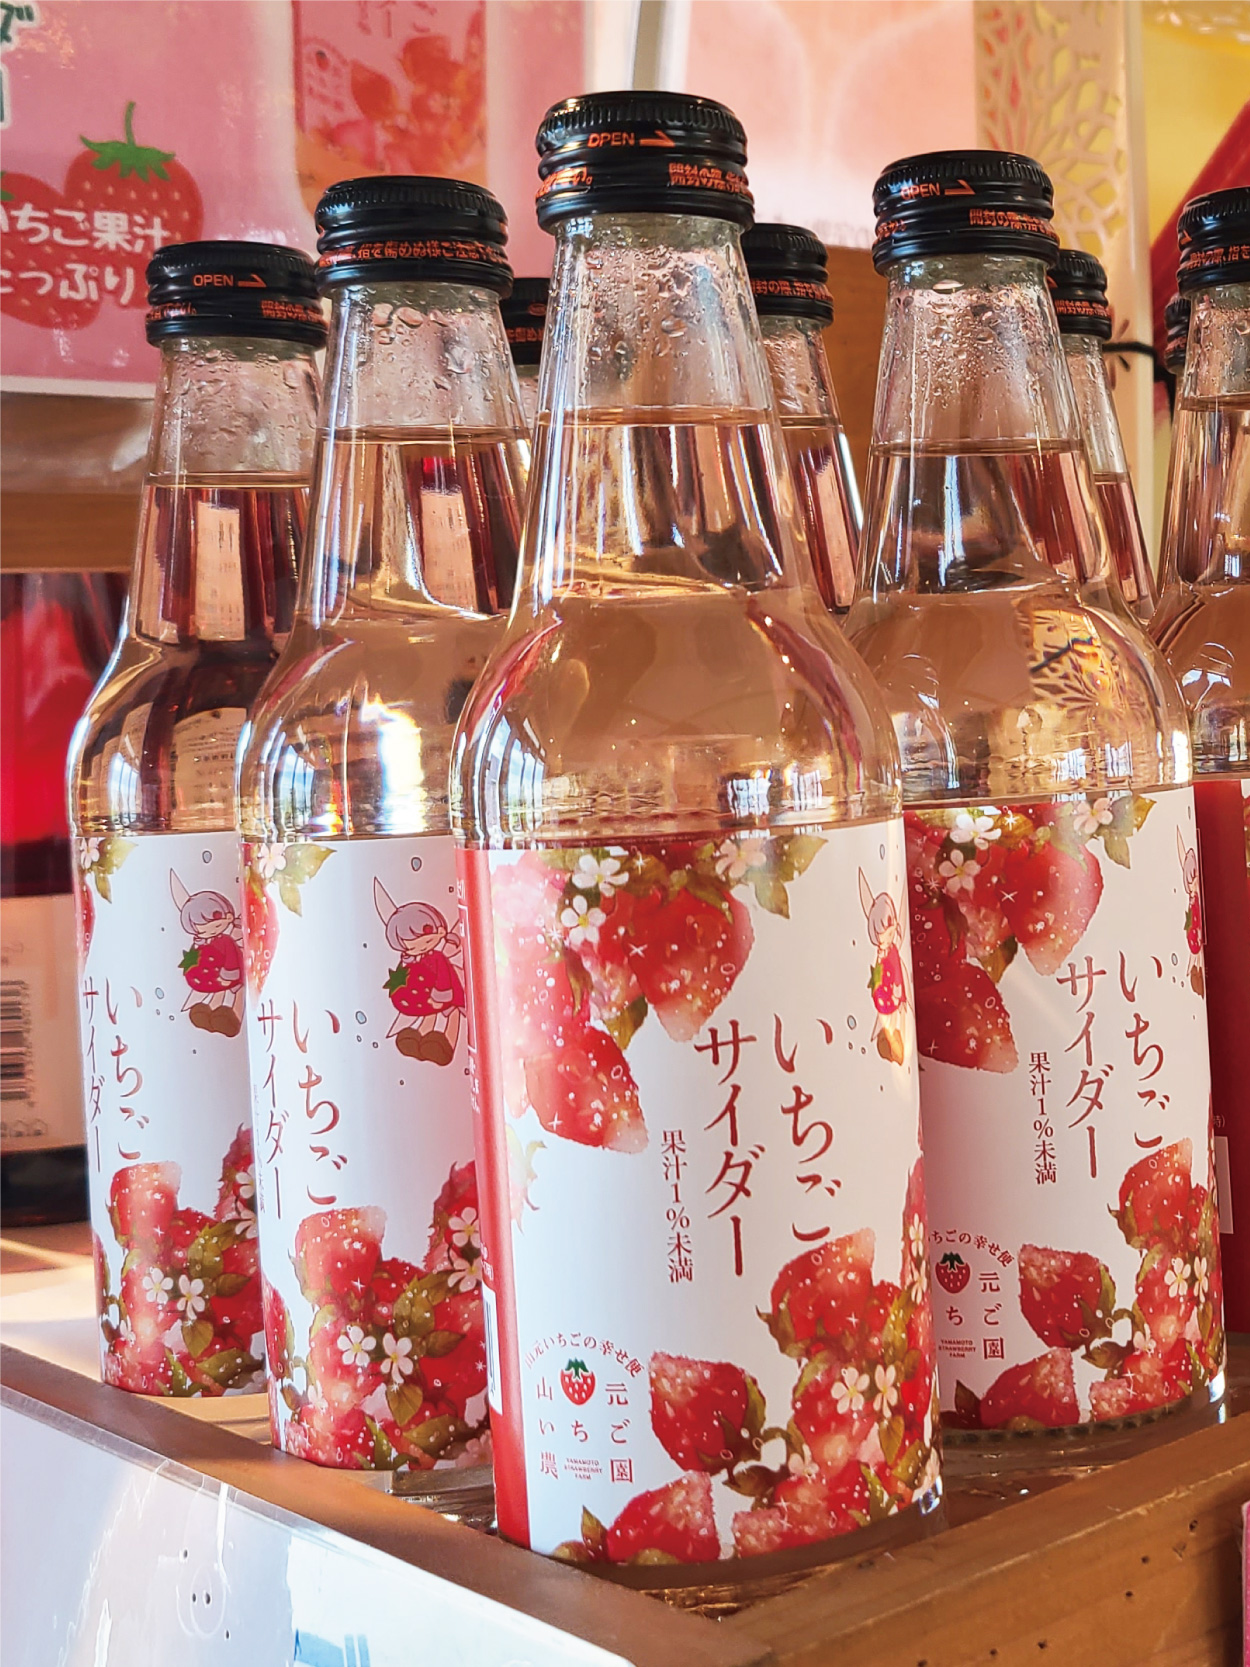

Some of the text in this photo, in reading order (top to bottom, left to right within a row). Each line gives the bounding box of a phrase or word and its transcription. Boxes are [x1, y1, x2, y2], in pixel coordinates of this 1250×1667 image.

[587, 132, 635, 148] OPEN
[900, 183, 940, 200] OPEN
[193, 274, 234, 288] OPEN
[83, 976, 105, 1173] サイダー
[106, 977, 150, 1160] いちご
[257, 998, 290, 1220] サイダー
[292, 998, 348, 1205] いちご
[1028, 1051, 1058, 1185] 果汁1%未満
[1057, 954, 1113, 1180] サイダー
[1118, 949, 1171, 1149] いちご
[693, 1019, 766, 1278] サイダー
[773, 1012, 841, 1242] いちご
[661, 1129, 694, 1283] 果汁1%未満
[929, 1229, 1015, 1268] ちごの幸せ便
[978, 1272, 1001, 1293] 元
[525, 1332, 645, 1378] 山元いちごの幸せ便
[982, 1337, 1005, 1360] 園
